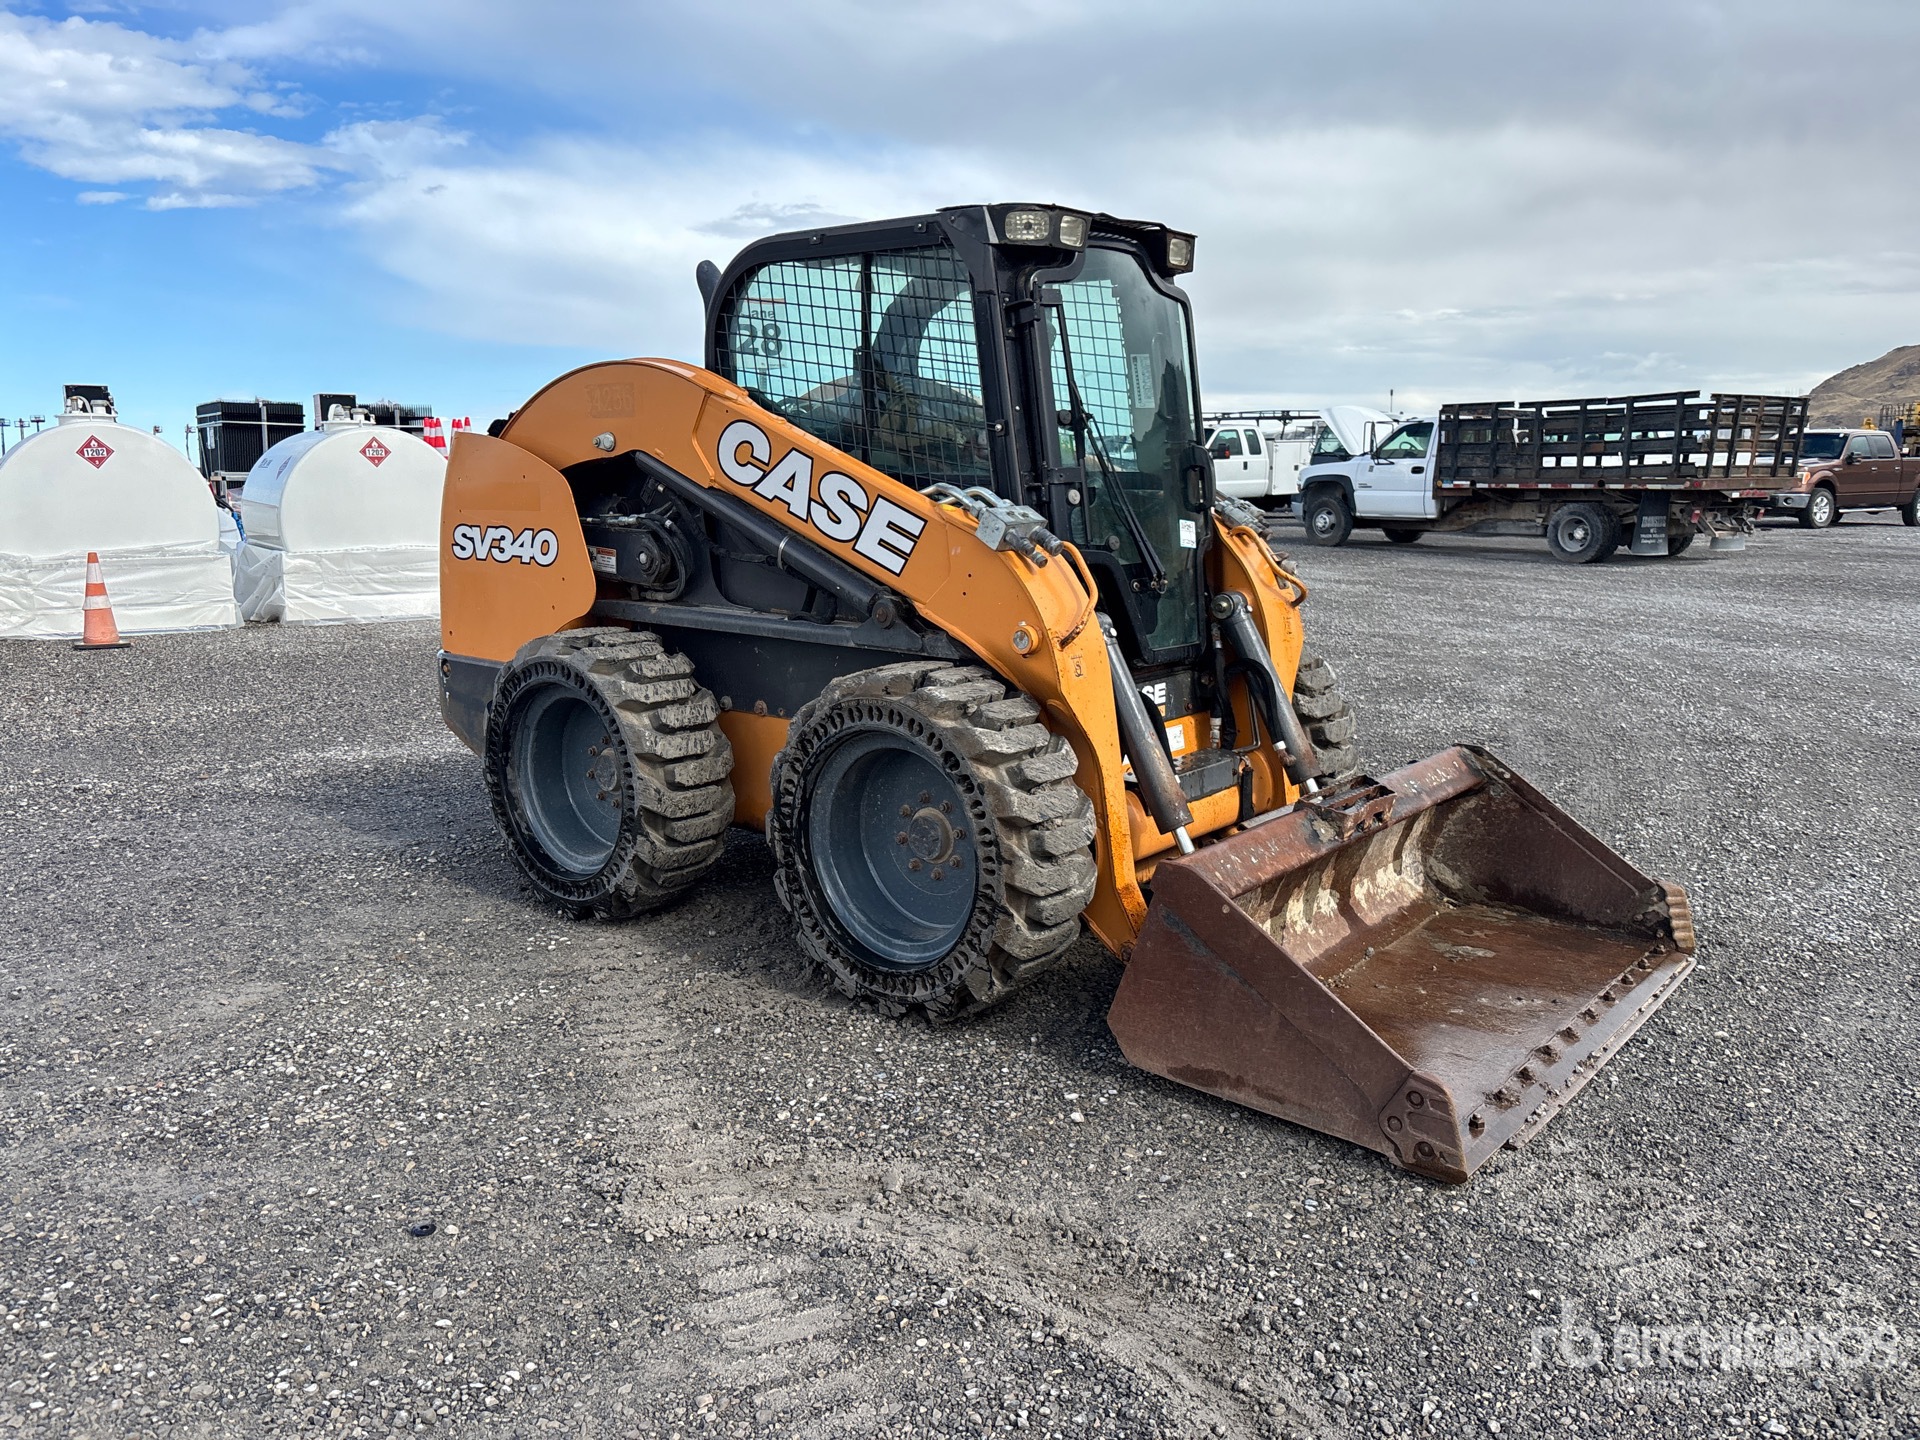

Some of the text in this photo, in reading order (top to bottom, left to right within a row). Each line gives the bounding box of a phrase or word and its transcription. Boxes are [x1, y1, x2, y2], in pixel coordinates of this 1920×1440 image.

[740, 308, 776, 319] ane
[737, 323, 783, 356] 28
[85, 448, 105, 456] 1202
[717, 419, 928, 577] CASE
[451, 523, 558, 567] SV340
